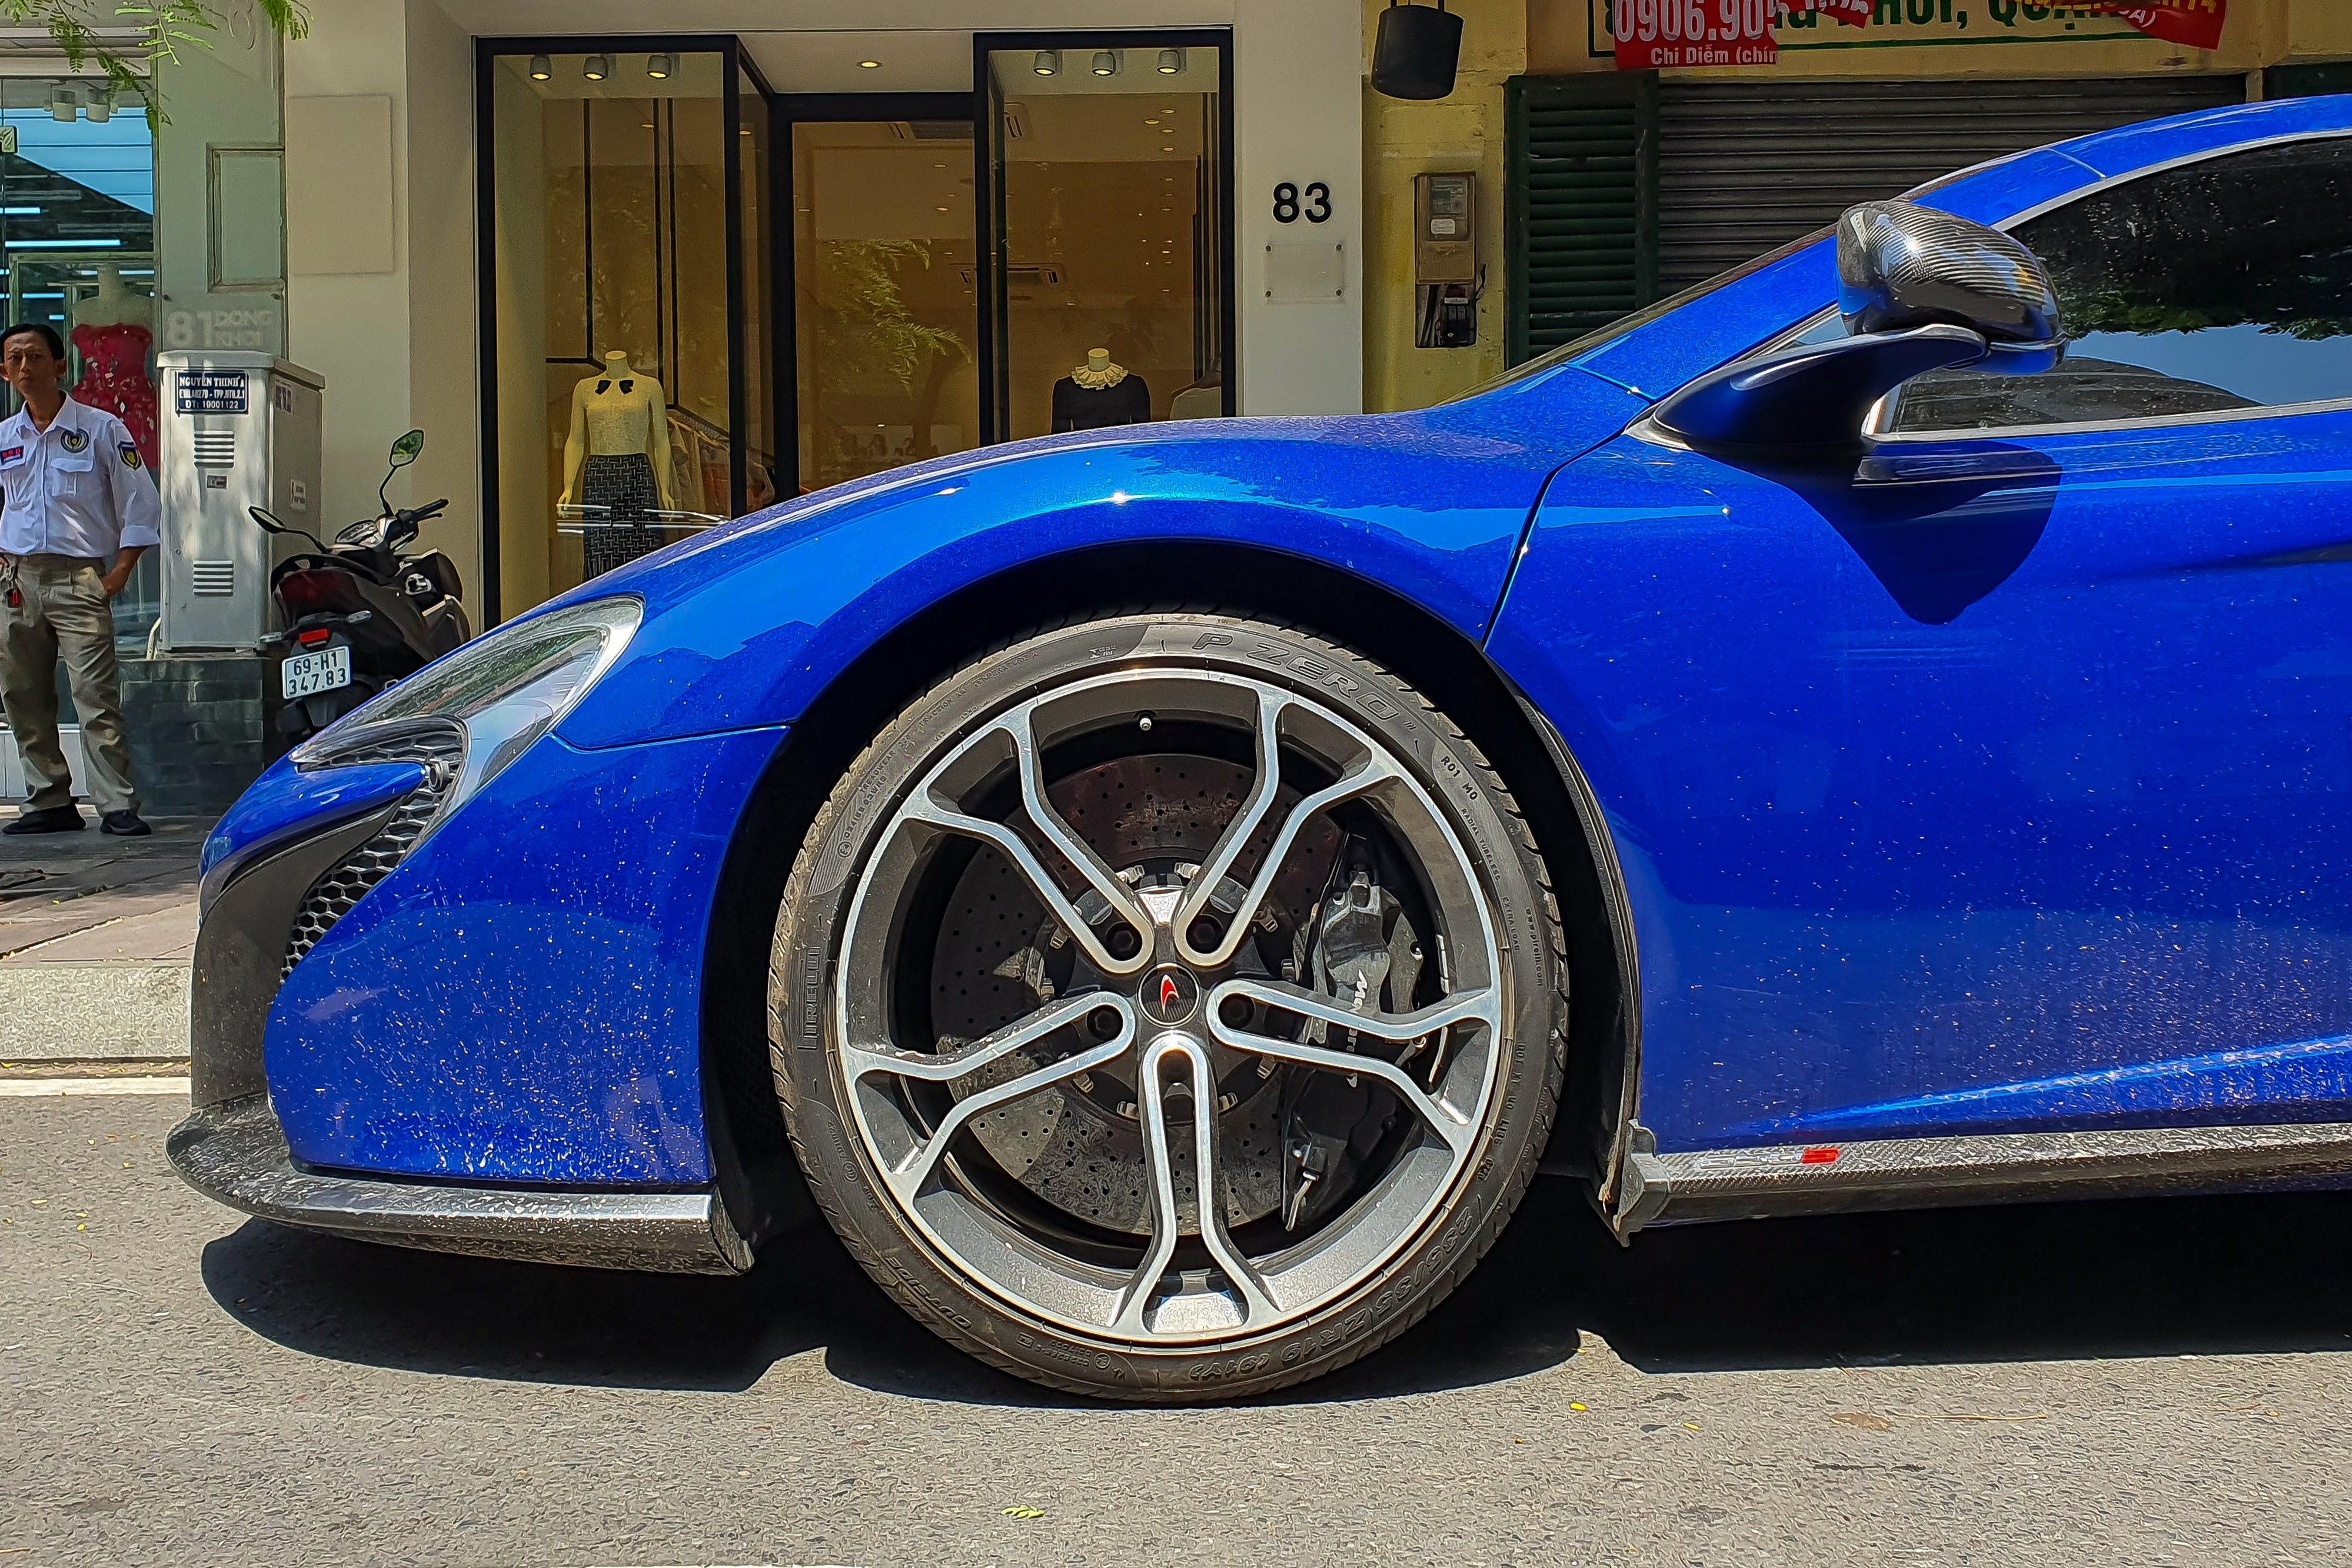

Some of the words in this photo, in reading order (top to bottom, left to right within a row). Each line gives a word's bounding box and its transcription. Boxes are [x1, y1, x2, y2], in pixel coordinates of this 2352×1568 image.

[1651, 47, 1679, 64] Chi
[1685, 44, 1729, 63] Diễm
[1272, 181, 1332, 224] 83
[167, 311, 212, 347] 81
[289, 667, 347, 695] 347.83
[1192, 631, 1234, 654] P
[1245, 639, 1401, 725] ZERO
[794, 943, 821, 1053] PIRELLI
[884, 1252, 973, 1330] OUTSIDE
